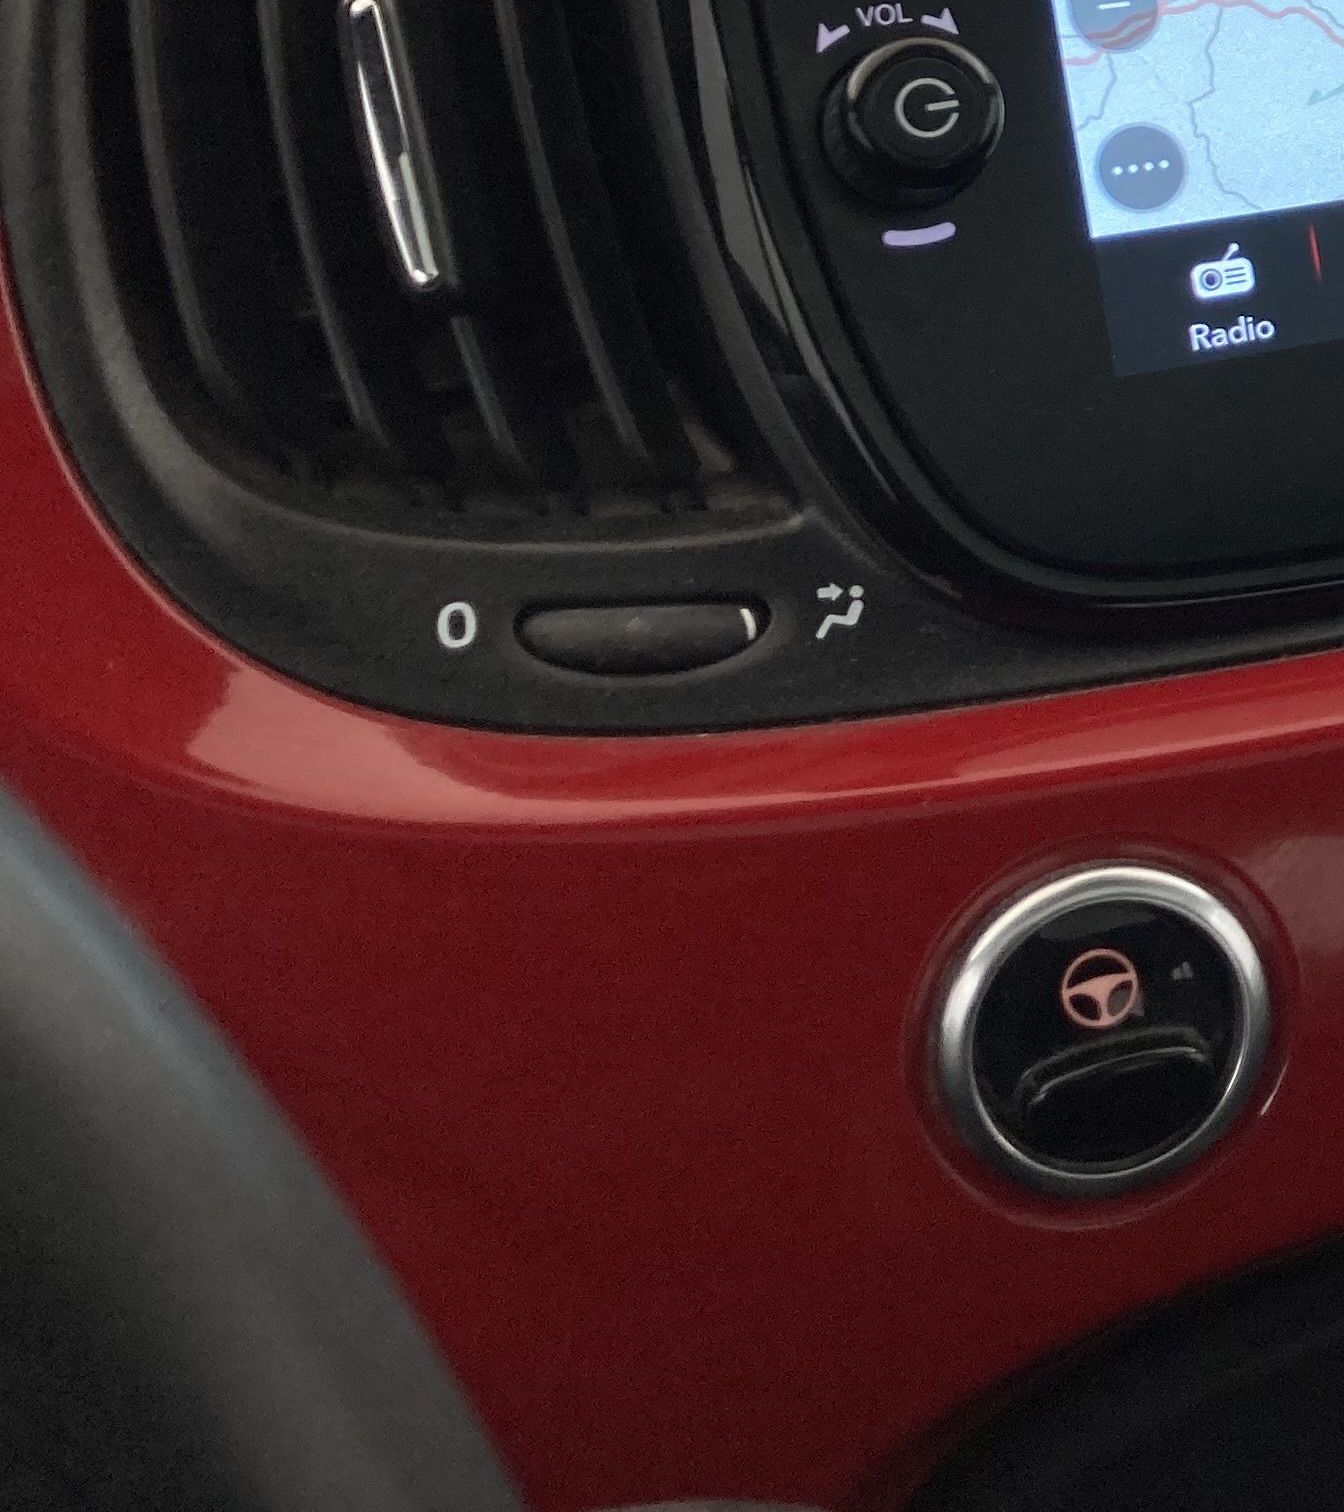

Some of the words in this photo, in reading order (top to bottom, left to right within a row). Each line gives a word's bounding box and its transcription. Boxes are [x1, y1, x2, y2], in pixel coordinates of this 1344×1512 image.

[855, 3, 914, 27] VOL
[1189, 316, 1275, 352] Radio
[437, 601, 477, 648] 0
